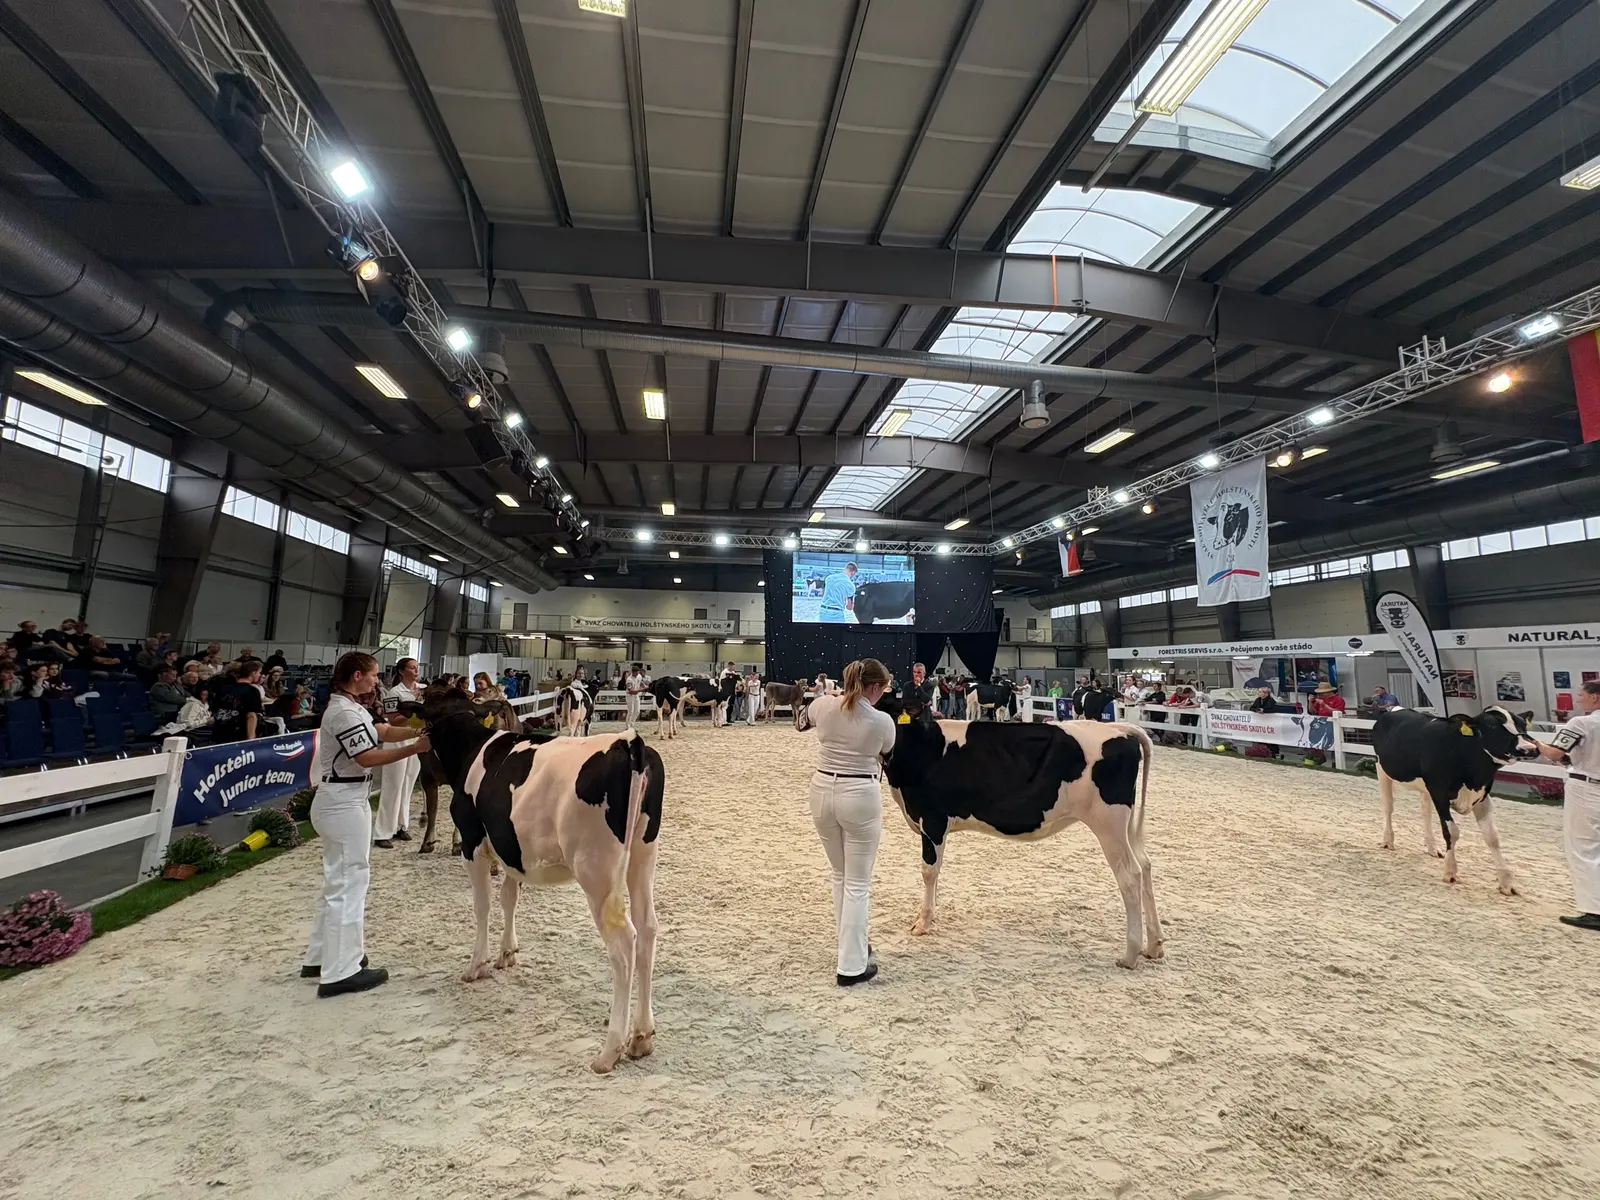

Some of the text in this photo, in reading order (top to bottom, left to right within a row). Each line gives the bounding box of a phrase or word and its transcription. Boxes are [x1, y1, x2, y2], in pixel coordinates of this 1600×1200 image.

[1248, 520, 1262, 550] SKOTU
[1230, 645, 1263, 653] Pečujeme
[1289, 642, 1313, 650] stádo
[1223, 714, 1252, 723] CHOVATELŮ
[1248, 725, 1267, 734] SKOTU
[1266, 725, 1276, 735] ČR
[349, 733, 366, 748] 44
[1561, 736, 1569, 744] 6
[193, 749, 256, 804] Holstein
[220, 769, 296, 808] Junior team
